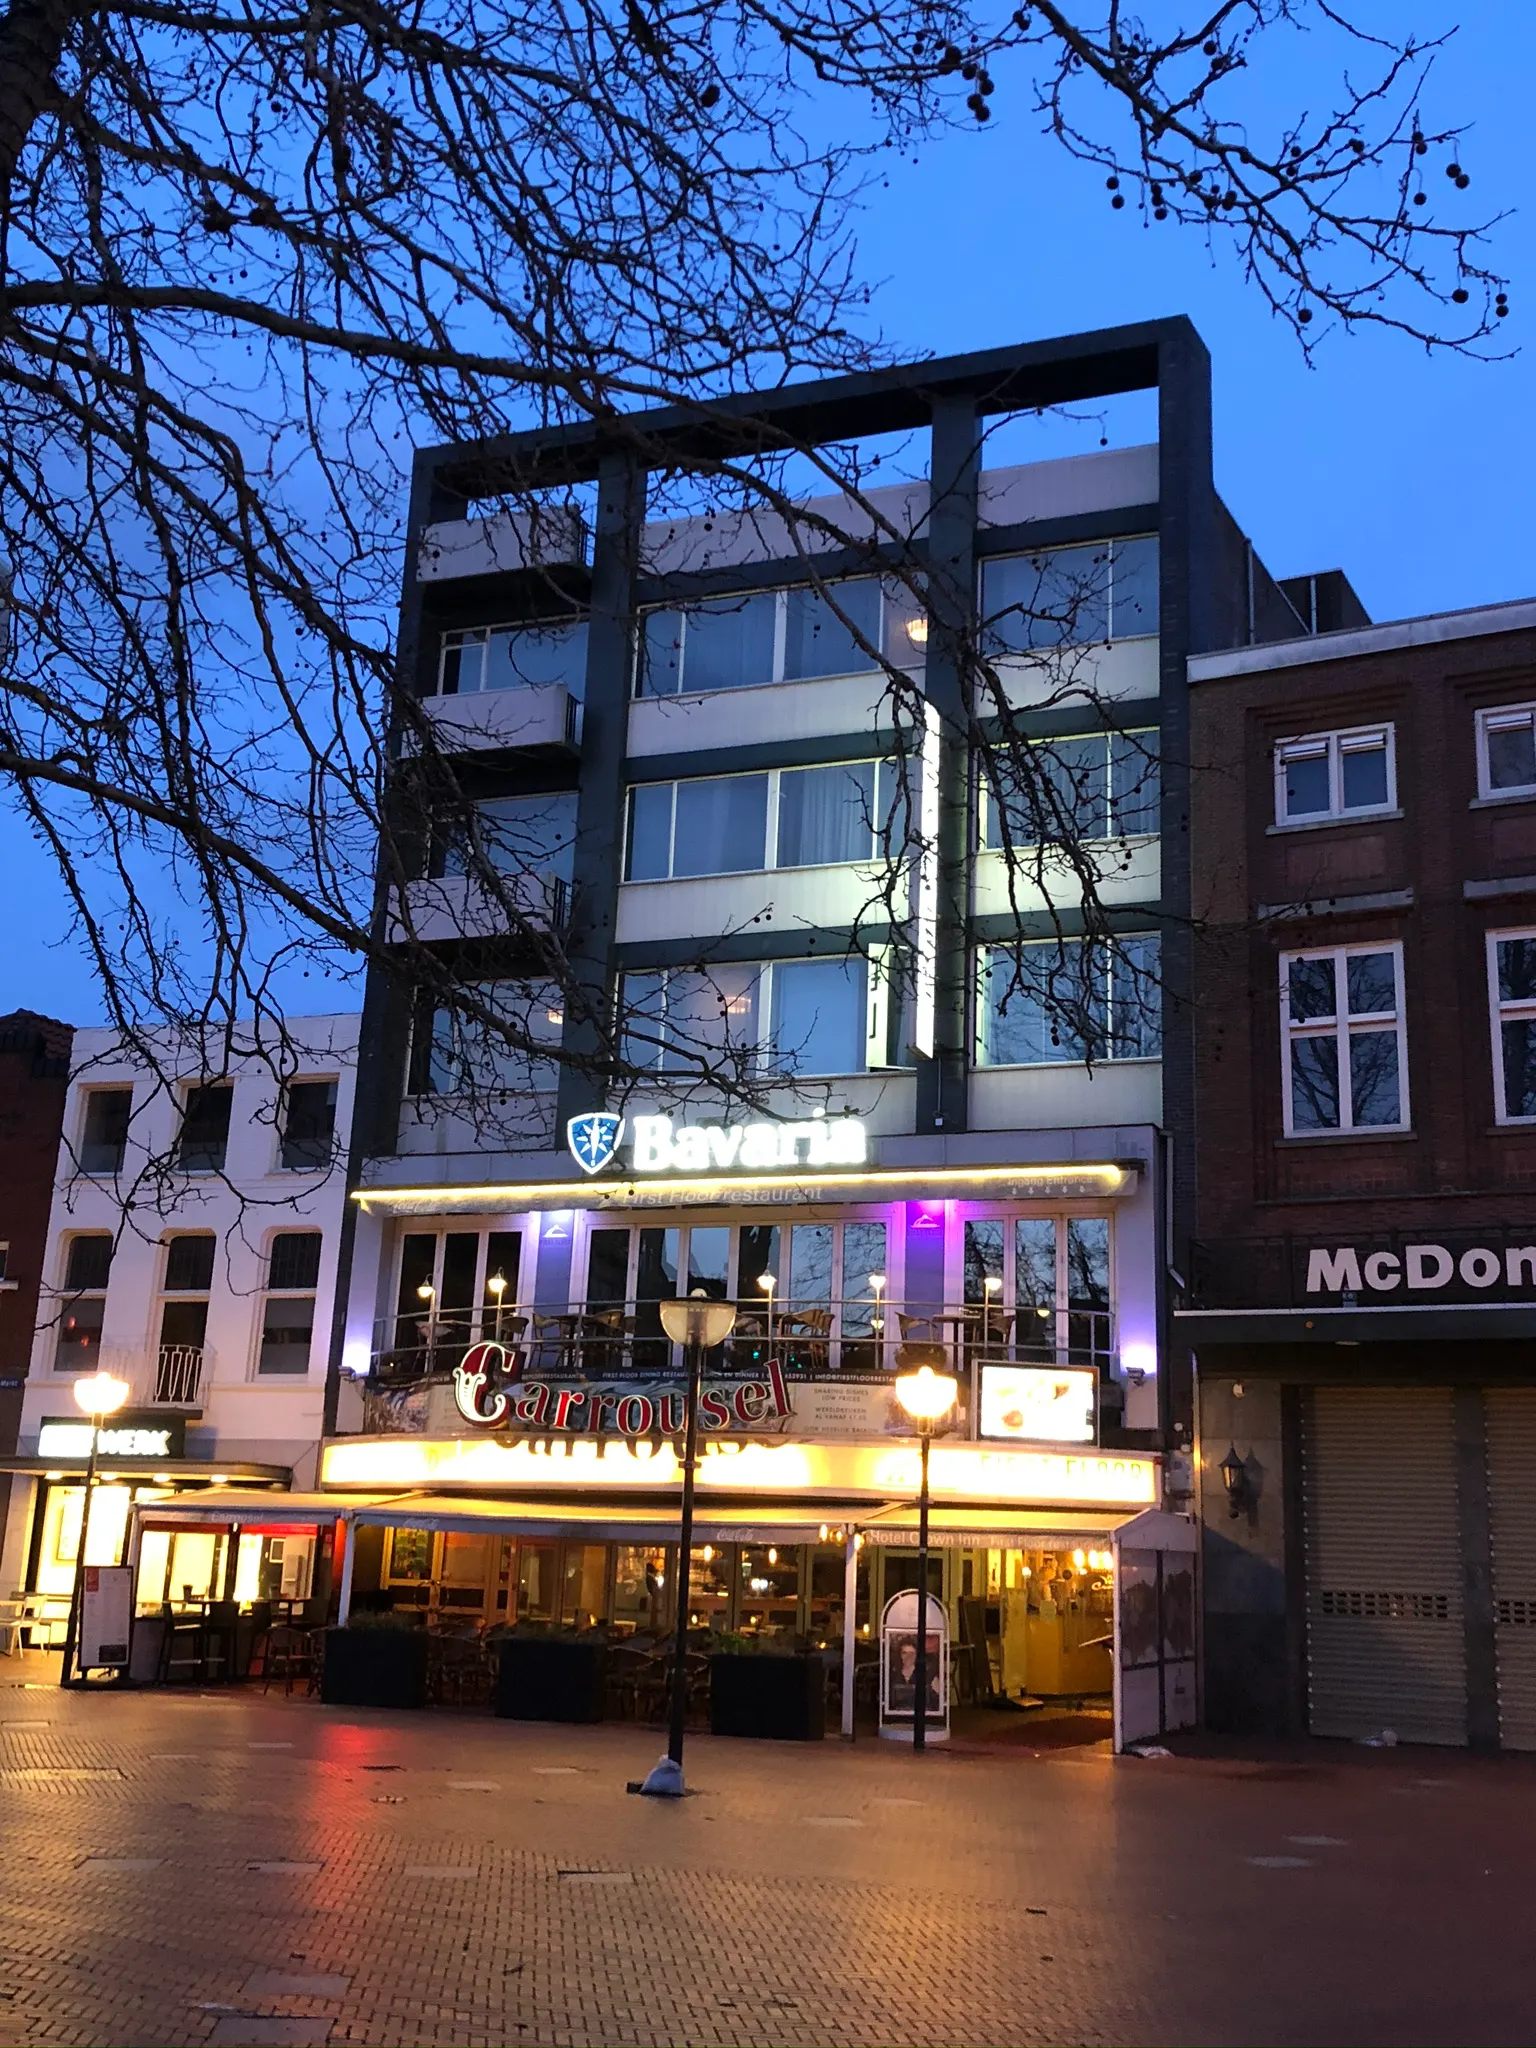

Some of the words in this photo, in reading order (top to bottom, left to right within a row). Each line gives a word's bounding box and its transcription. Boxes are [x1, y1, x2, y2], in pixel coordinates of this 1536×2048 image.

[633, 1107, 866, 1170] Bavaria
[723, 1186, 822, 1203] restaurant
[1306, 1244, 1536, 1292] McDon
[453, 1341, 794, 1436] Carrousel
[869, 1531, 906, 1545] Hotel
[909, 1532, 955, 1546] Cown
[958, 1533, 981, 1546] Inn
